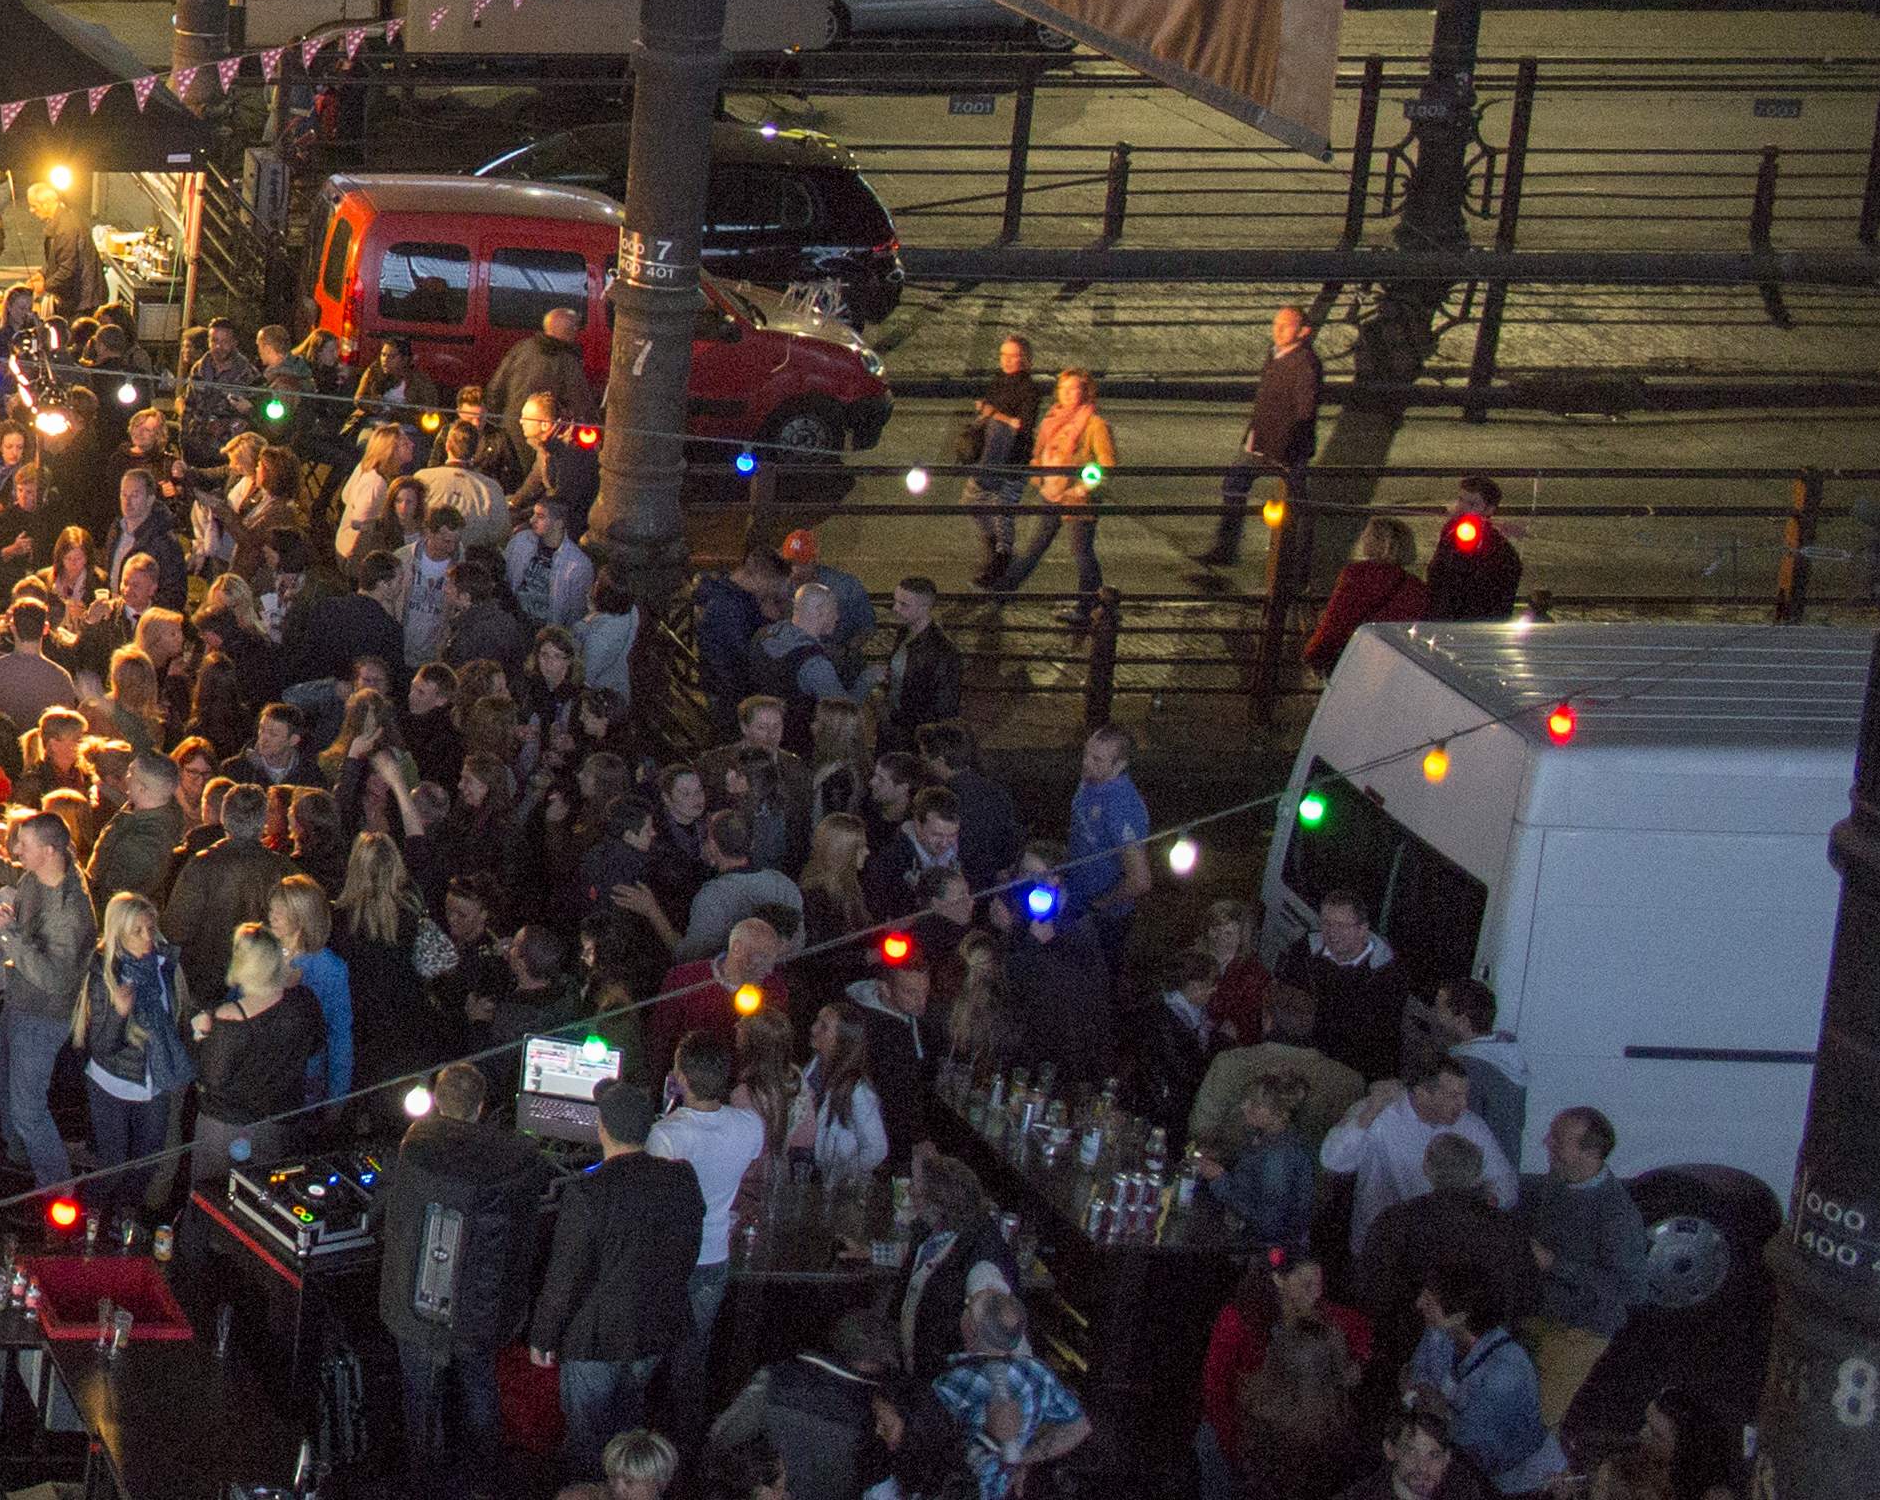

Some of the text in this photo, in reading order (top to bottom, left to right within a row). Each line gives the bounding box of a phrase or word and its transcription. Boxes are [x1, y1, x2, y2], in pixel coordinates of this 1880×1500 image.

[656, 240, 673, 261] 7
[646, 266, 674, 279] 401
[632, 339, 654, 376] 7
[1806, 1191, 1865, 1231] 000
[1833, 1356, 1880, 1427] 8
